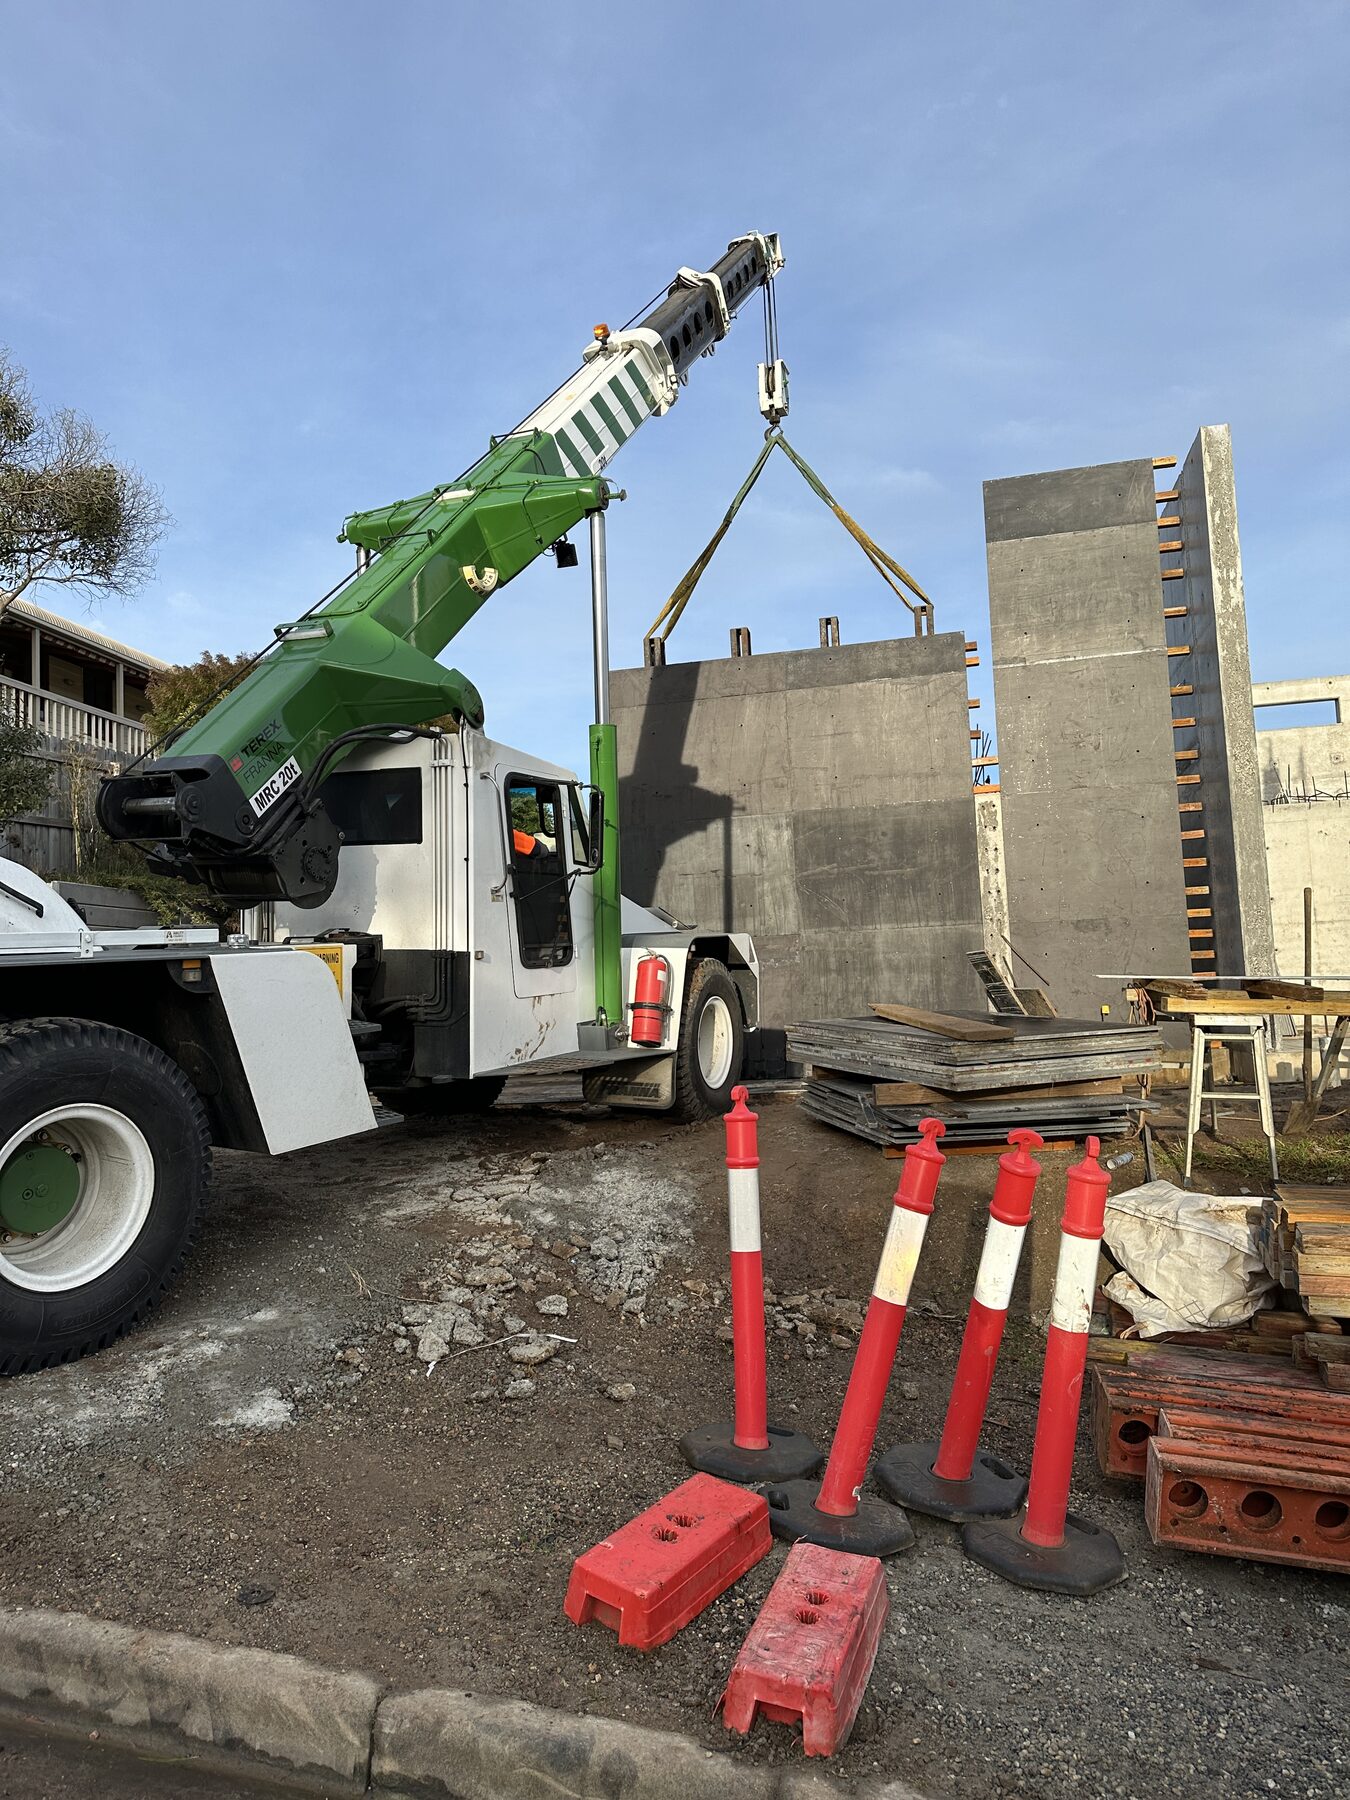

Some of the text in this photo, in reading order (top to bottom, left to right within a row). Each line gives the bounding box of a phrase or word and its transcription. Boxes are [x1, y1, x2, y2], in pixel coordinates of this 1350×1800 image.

[241, 720, 281, 758] TEREX
[243, 742, 285, 783] FRANNA
[254, 762, 298, 811] MRC 20t
[316, 952, 340, 963] ARNING
